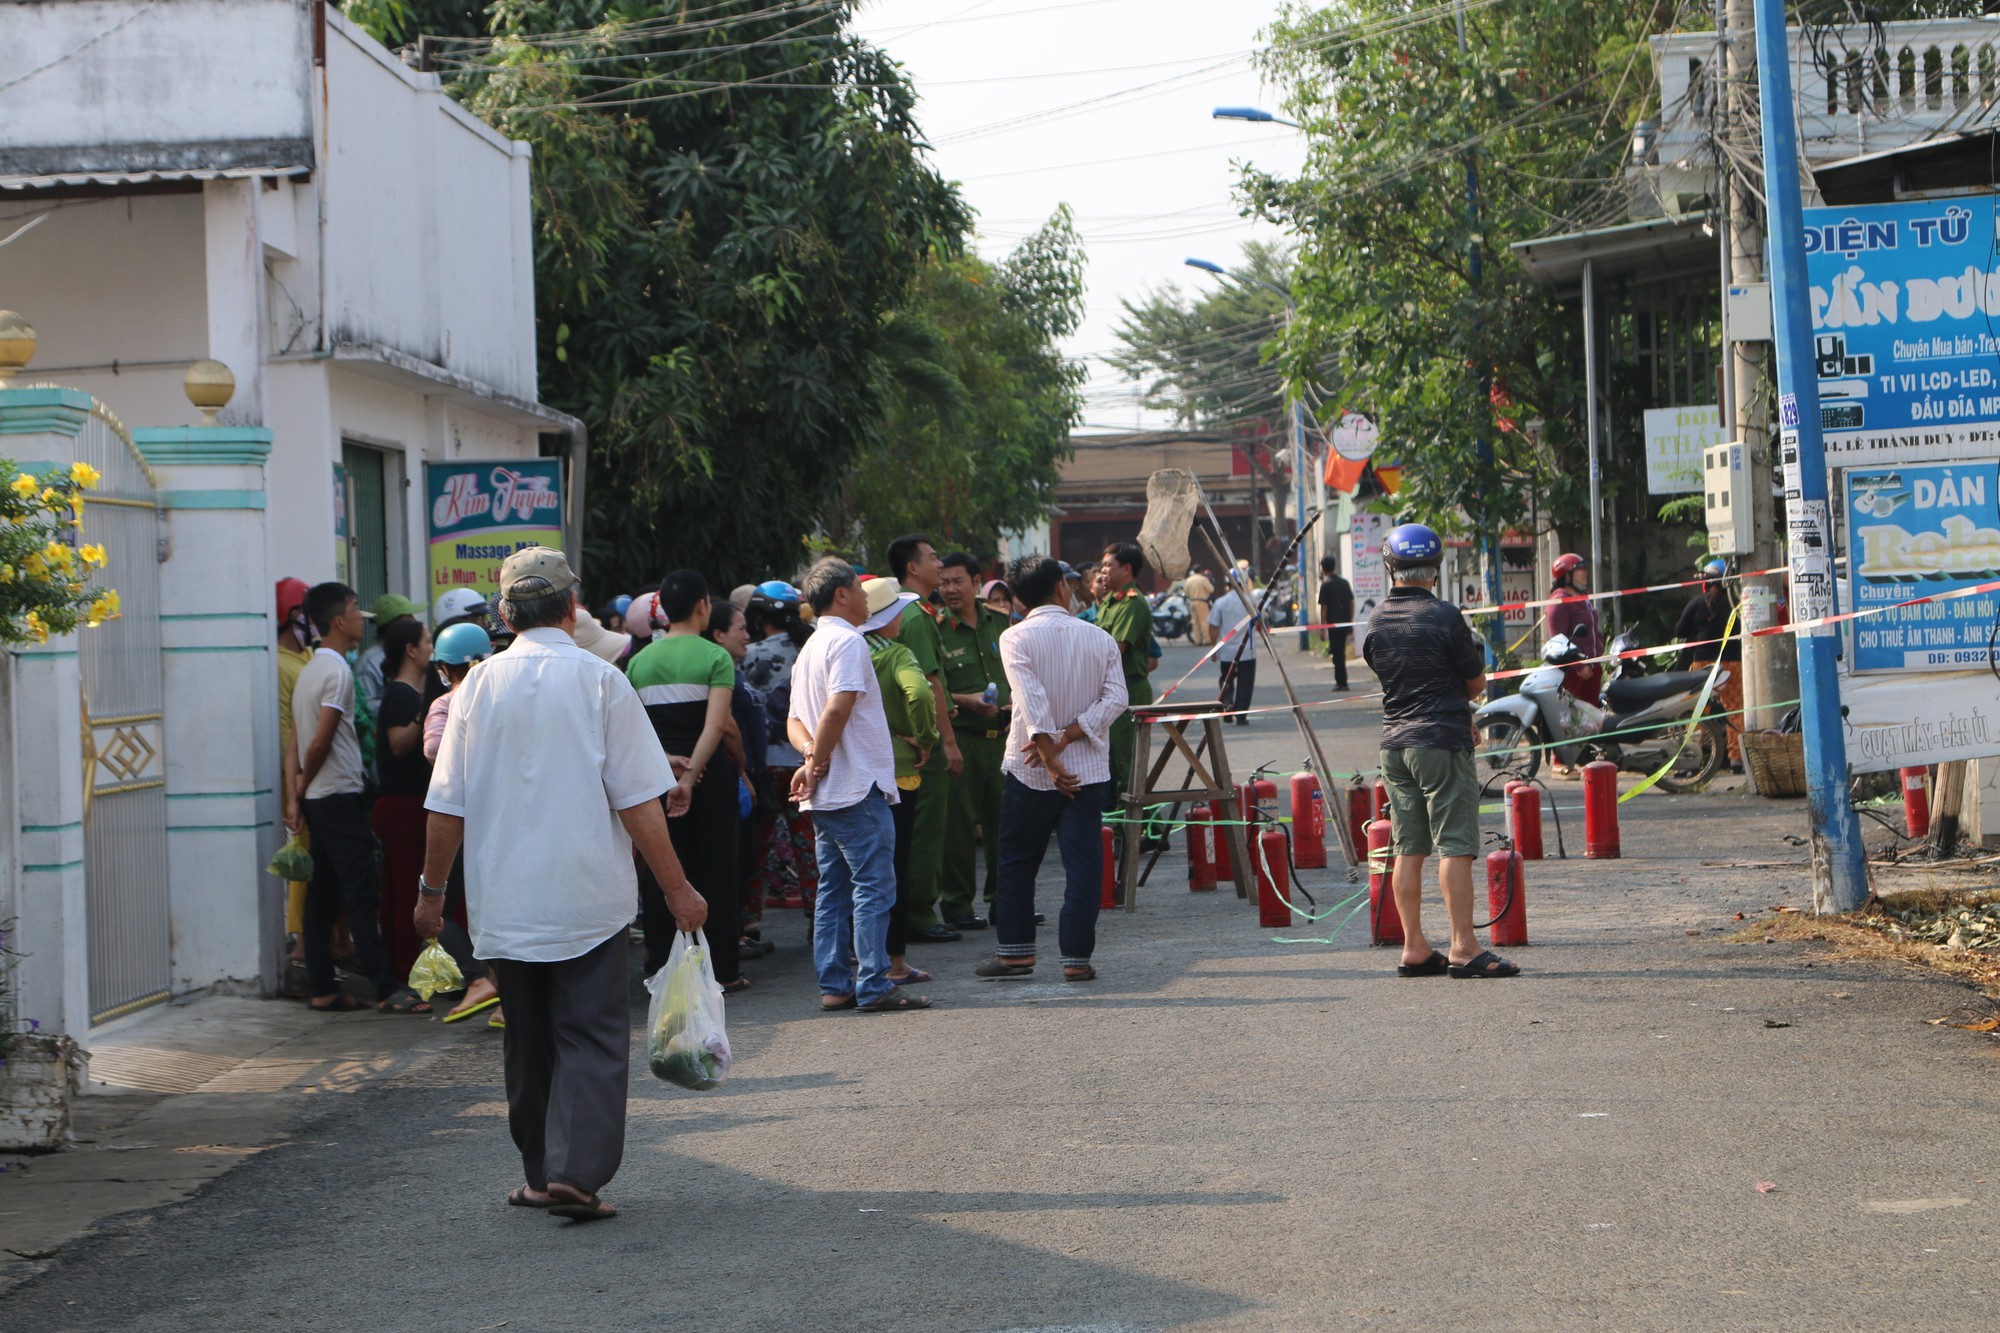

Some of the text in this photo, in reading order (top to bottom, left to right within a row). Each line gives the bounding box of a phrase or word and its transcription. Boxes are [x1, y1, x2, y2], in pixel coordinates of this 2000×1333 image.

[1909, 205, 1972, 247] TỬ
[1893, 337, 1929, 361] Chuyên
[1932, 336, 1952, 357] Mua
[1880, 375, 1895, 393] TI
[1900, 374, 1916, 391] VI
[1911, 394, 1944, 420] ĐẦU
[1948, 394, 1975, 418] ĐĨA
[1846, 436, 1864, 451] LÊ
[1868, 433, 1920, 450] THÀNH
[1924, 433, 1955, 446] DUY
[433, 473, 490, 529] Kim
[1914, 469, 1985, 510] DÀN
[456, 543, 512, 561] Massage
[1860, 584, 1915, 599] Chuyên:
[1953, 596, 1975, 619] ĐÁM
[1977, 594, 1994, 618] HỎI
[1859, 630, 1878, 649] CHO
[1880, 624, 1905, 648] THUÊ
[1907, 624, 1922, 647] ÂM
[1924, 627, 1955, 646] THANH
[1963, 622, 1982, 644] ÁNH
[1954, 650, 1988, 663] 0932
[1860, 728, 1899, 764] QUẠT
[1972, 706, 1991, 745] ỦI
